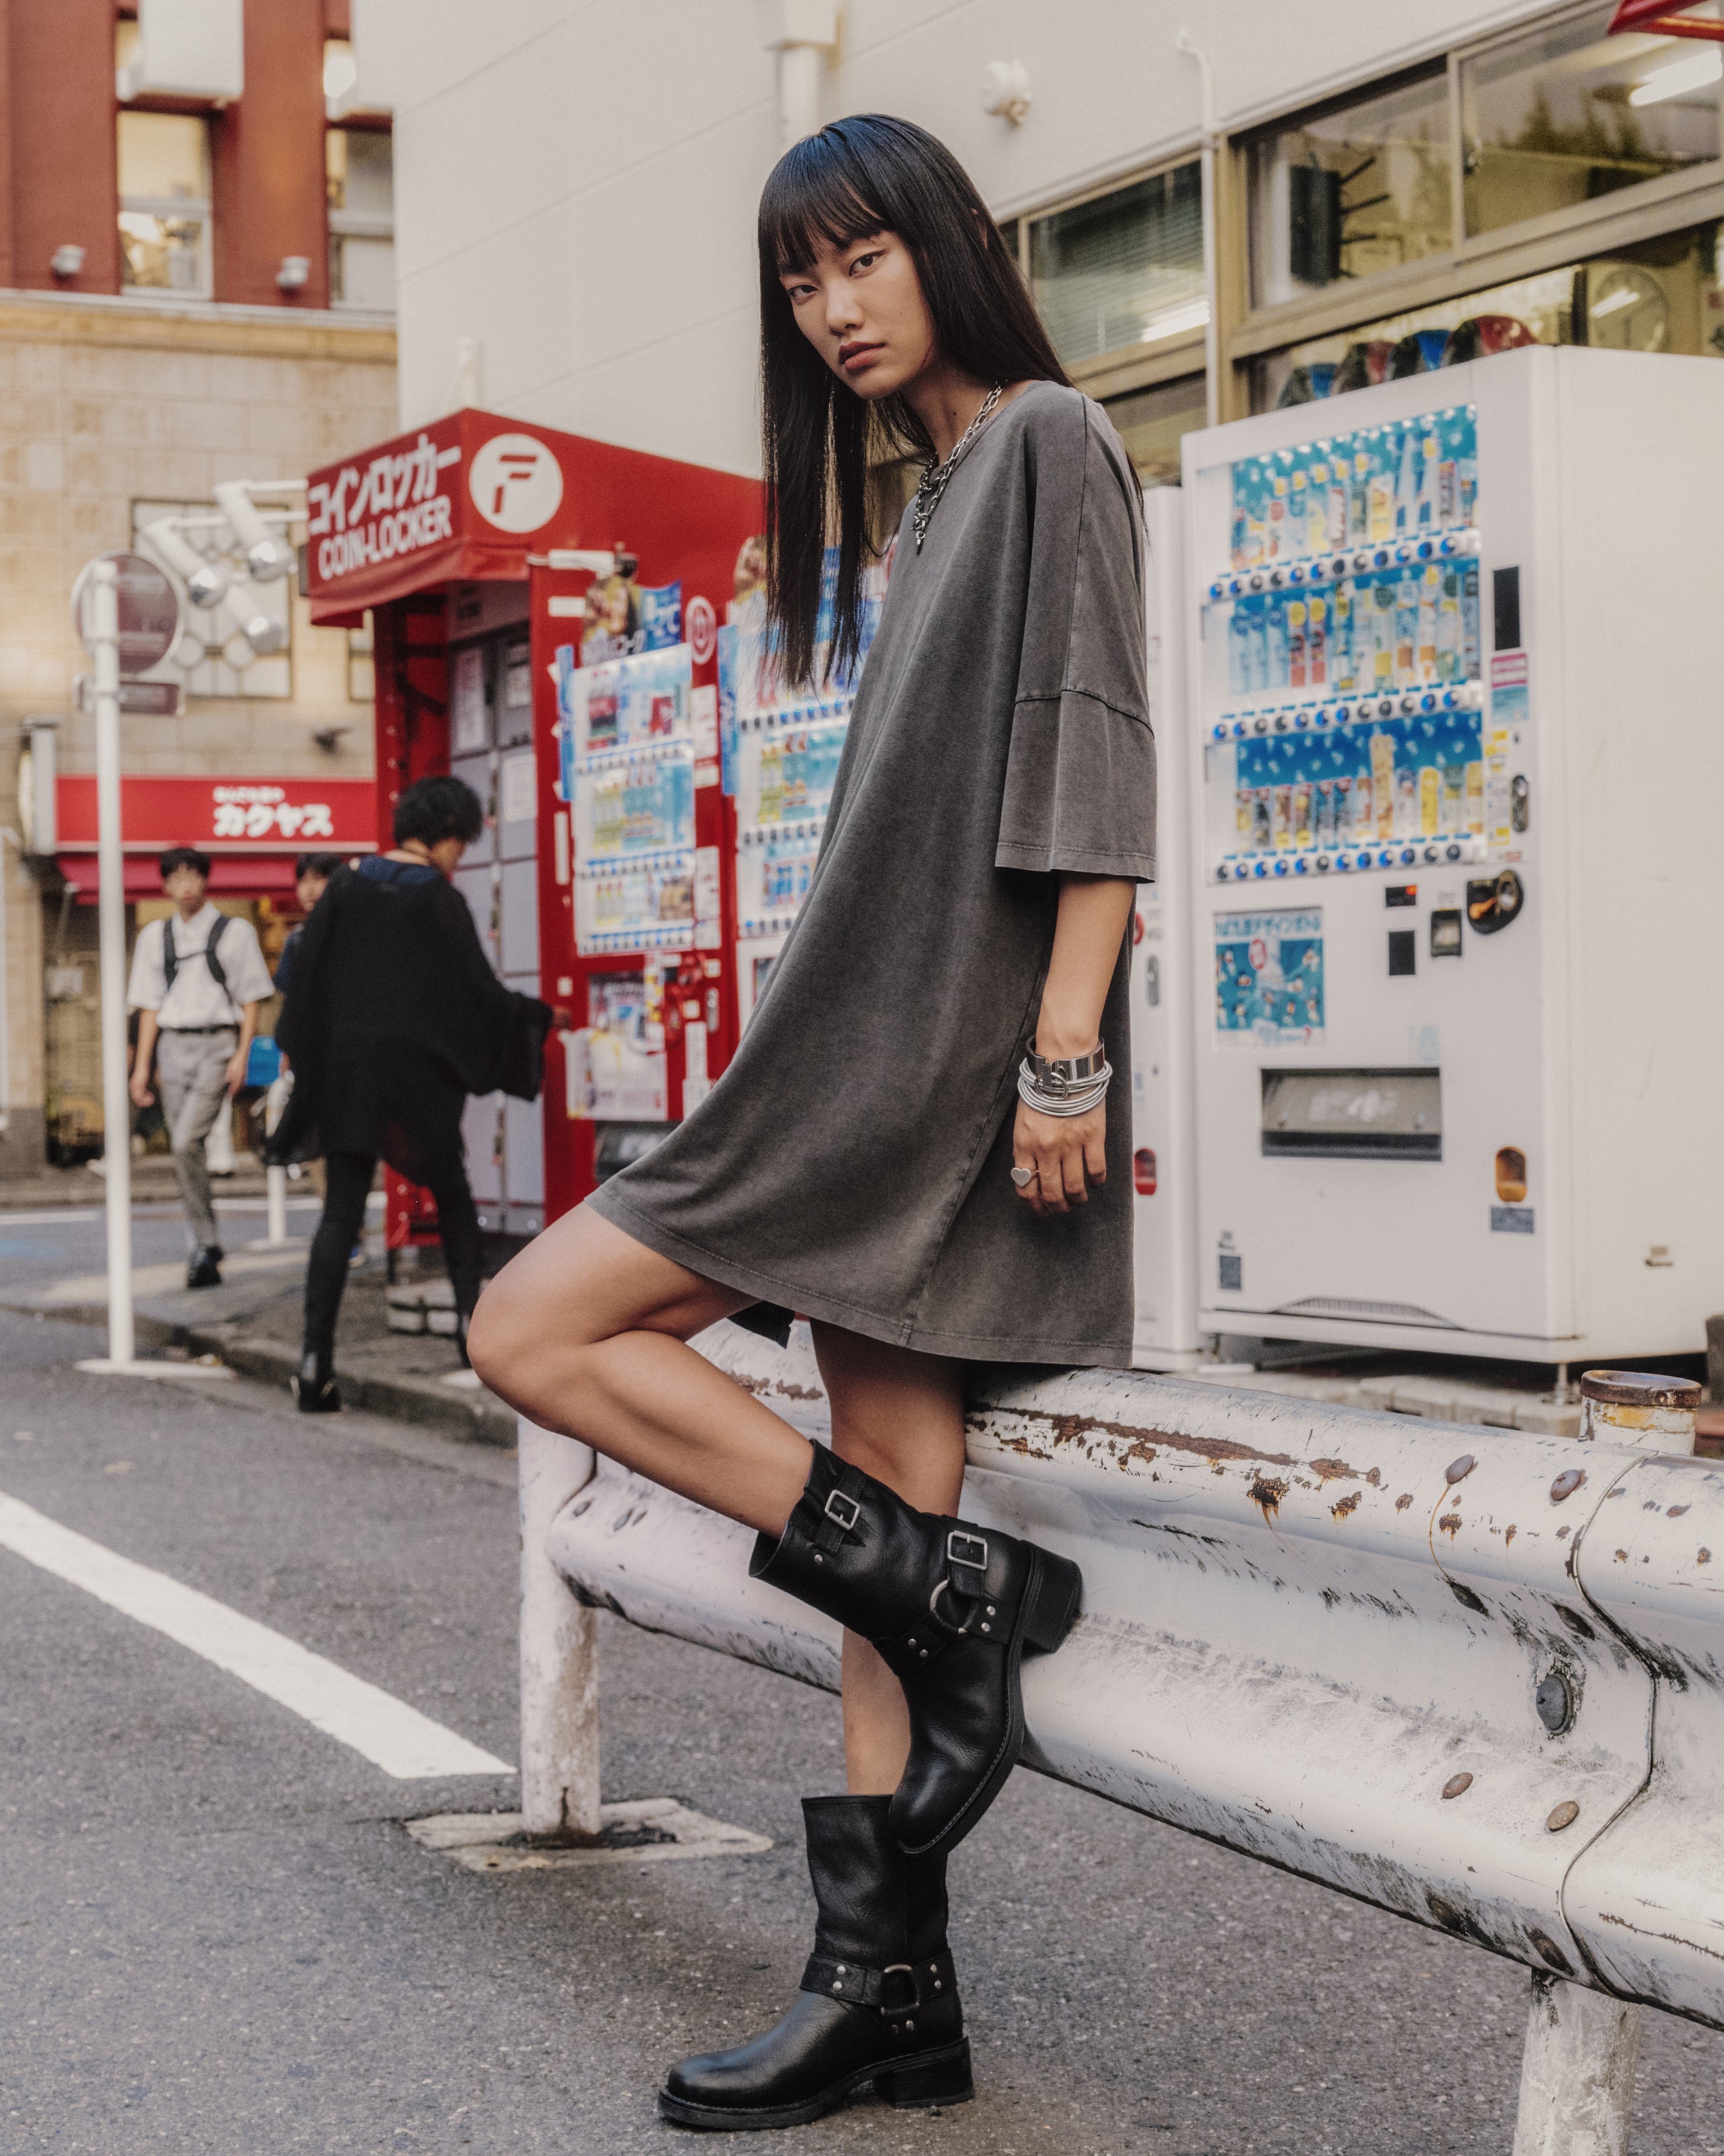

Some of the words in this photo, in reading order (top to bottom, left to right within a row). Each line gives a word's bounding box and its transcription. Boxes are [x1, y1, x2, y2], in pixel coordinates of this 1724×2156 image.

[308, 432, 462, 535] コインロッカー
[318, 494, 453, 581] COIN-LOCKER
[213, 802, 334, 838] カクヤス
